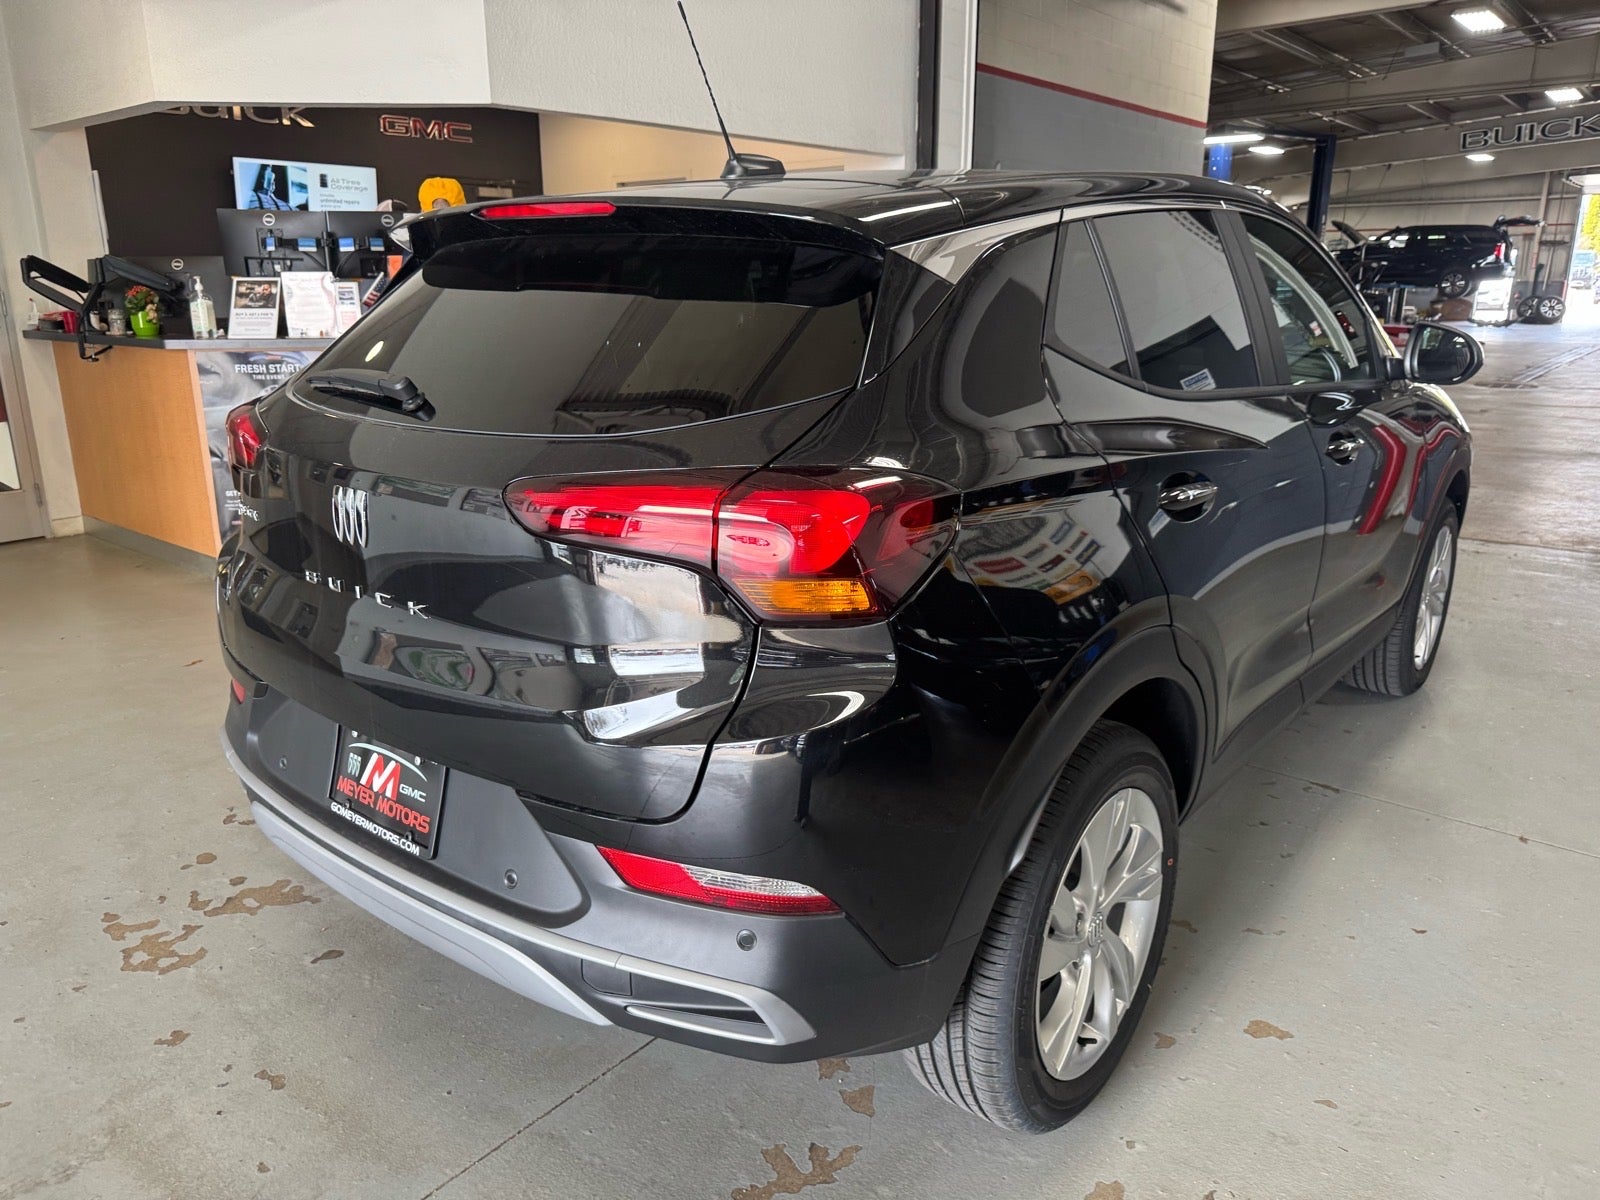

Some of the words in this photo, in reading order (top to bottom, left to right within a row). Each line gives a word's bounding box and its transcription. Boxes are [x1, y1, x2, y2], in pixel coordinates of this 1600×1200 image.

[379, 114, 473, 143] GMC
[1460, 113, 1600, 151] BUICK
[331, 183, 368, 193] Coverage
[341, 178, 361, 186] Tires
[235, 364, 267, 373] FRESH
[268, 363, 300, 373] START
[305, 569, 431, 621] BUICK
[336, 775, 376, 809] MEYER
[375, 795, 431, 834] MOTORS
[399, 783, 427, 803] GMC
[330, 801, 421, 857] GOMEYERMOTORS.COM
